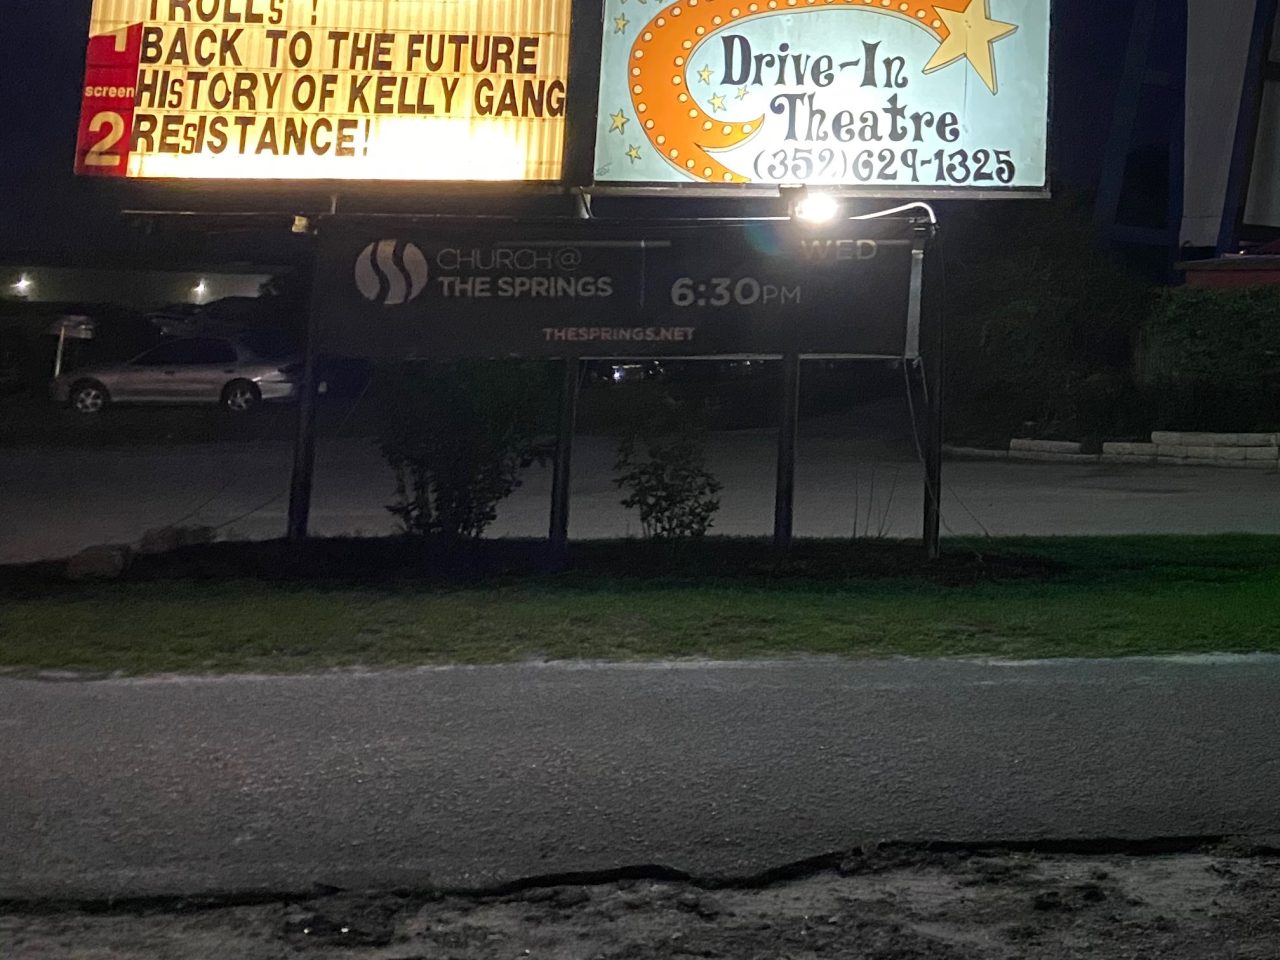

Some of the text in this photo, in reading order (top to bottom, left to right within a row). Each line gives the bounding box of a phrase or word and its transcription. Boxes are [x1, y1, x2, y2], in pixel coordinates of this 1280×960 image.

[140, 26, 540, 74] BACK TO THE FUTURE
[720, 34, 909, 89] Drive-In
[84, 85, 135, 99] screen
[292, 74, 338, 112] OF
[347, 74, 460, 115] KELLY
[474, 77, 566, 118] GANG
[769, 93, 961, 143] Theatre
[84, 111, 125, 166] 2
[436, 248, 551, 271] CHURCH
[801, 239, 879, 261] WED
[438, 275, 613, 298] THE SPRINGS
[542, 327, 696, 341] THESPRINGS.NET
